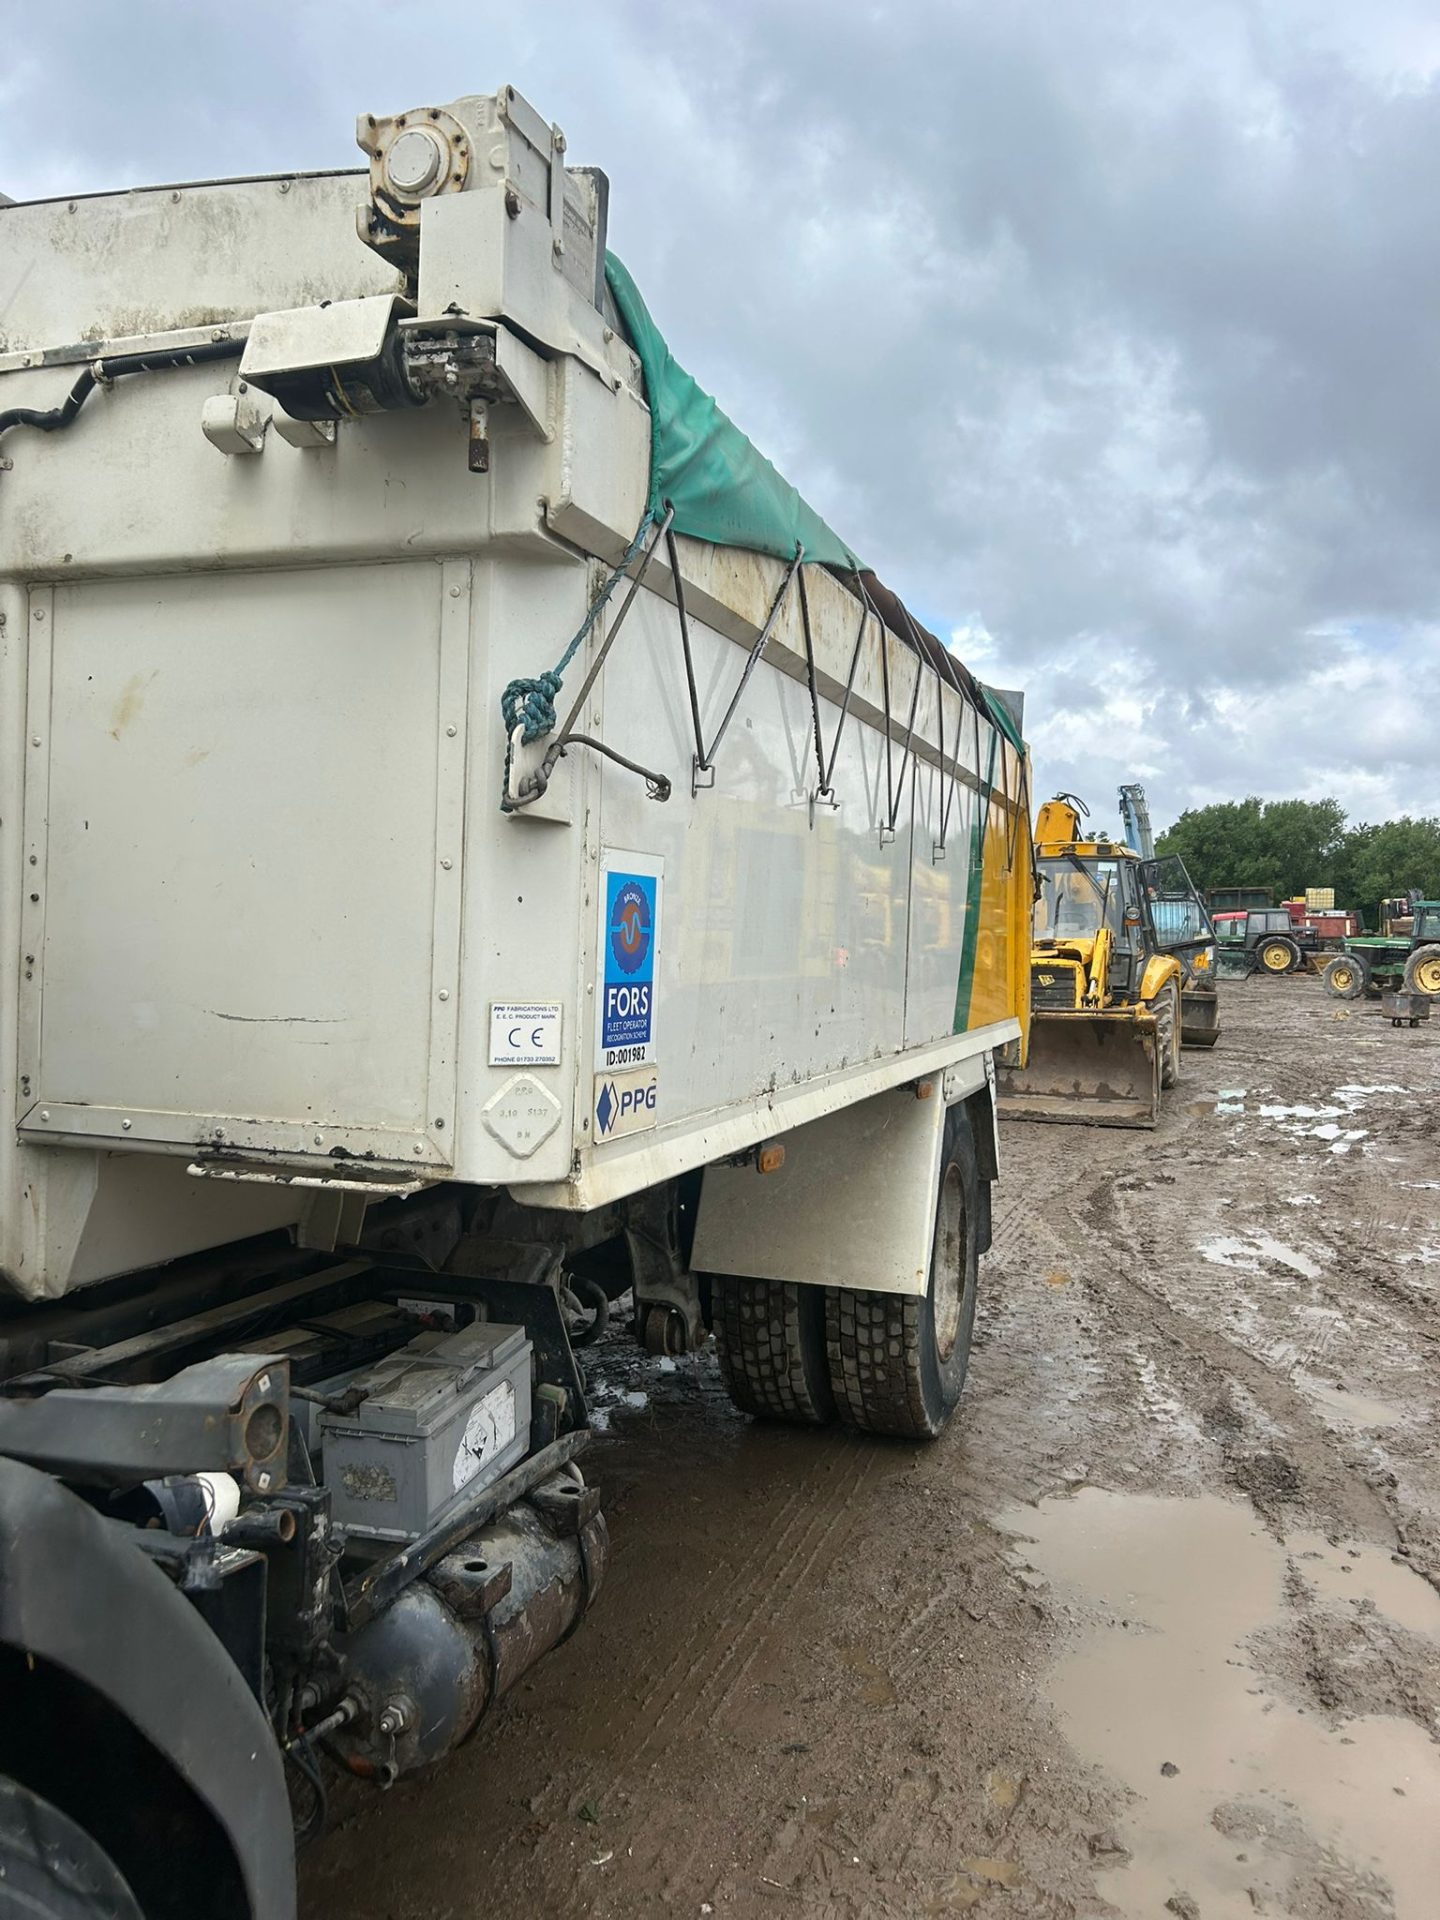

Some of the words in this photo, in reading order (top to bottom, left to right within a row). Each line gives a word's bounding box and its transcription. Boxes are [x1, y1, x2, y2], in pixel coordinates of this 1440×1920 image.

[607, 986, 649, 1018] FORS
[607, 1021, 622, 1032] FLEET
[622, 1019, 647, 1031] OPERATOR
[606, 1045, 646, 1066] ID:001982
[621, 1085, 656, 1116] PPG
